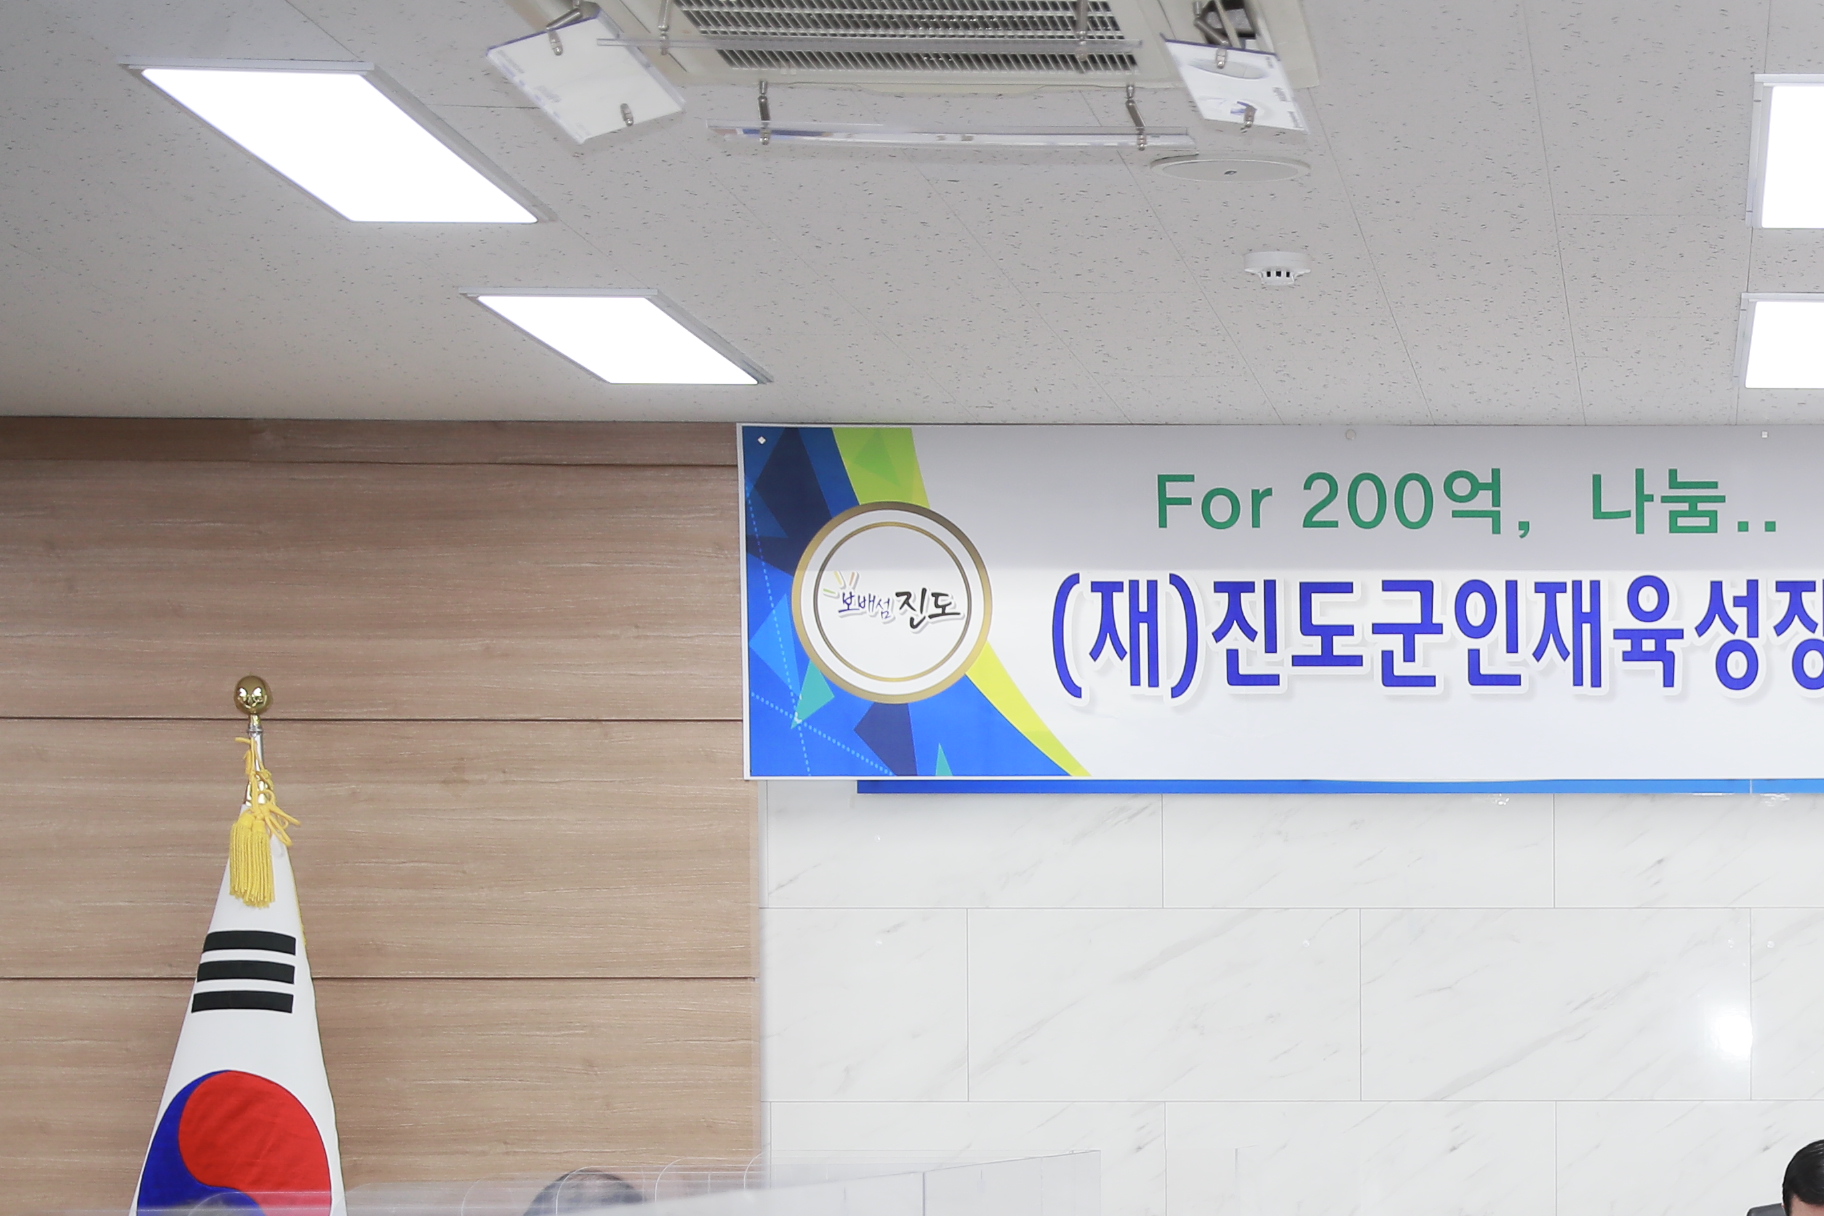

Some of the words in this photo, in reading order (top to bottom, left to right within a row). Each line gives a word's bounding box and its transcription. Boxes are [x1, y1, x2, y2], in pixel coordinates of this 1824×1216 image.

[1157, 473, 1273, 530] For
[1302, 467, 1532, 539] 200억,
[1591, 467, 1778, 535] 나눔..
[838, 590, 891, 619] 보배섬
[895, 587, 961, 629] 진도
